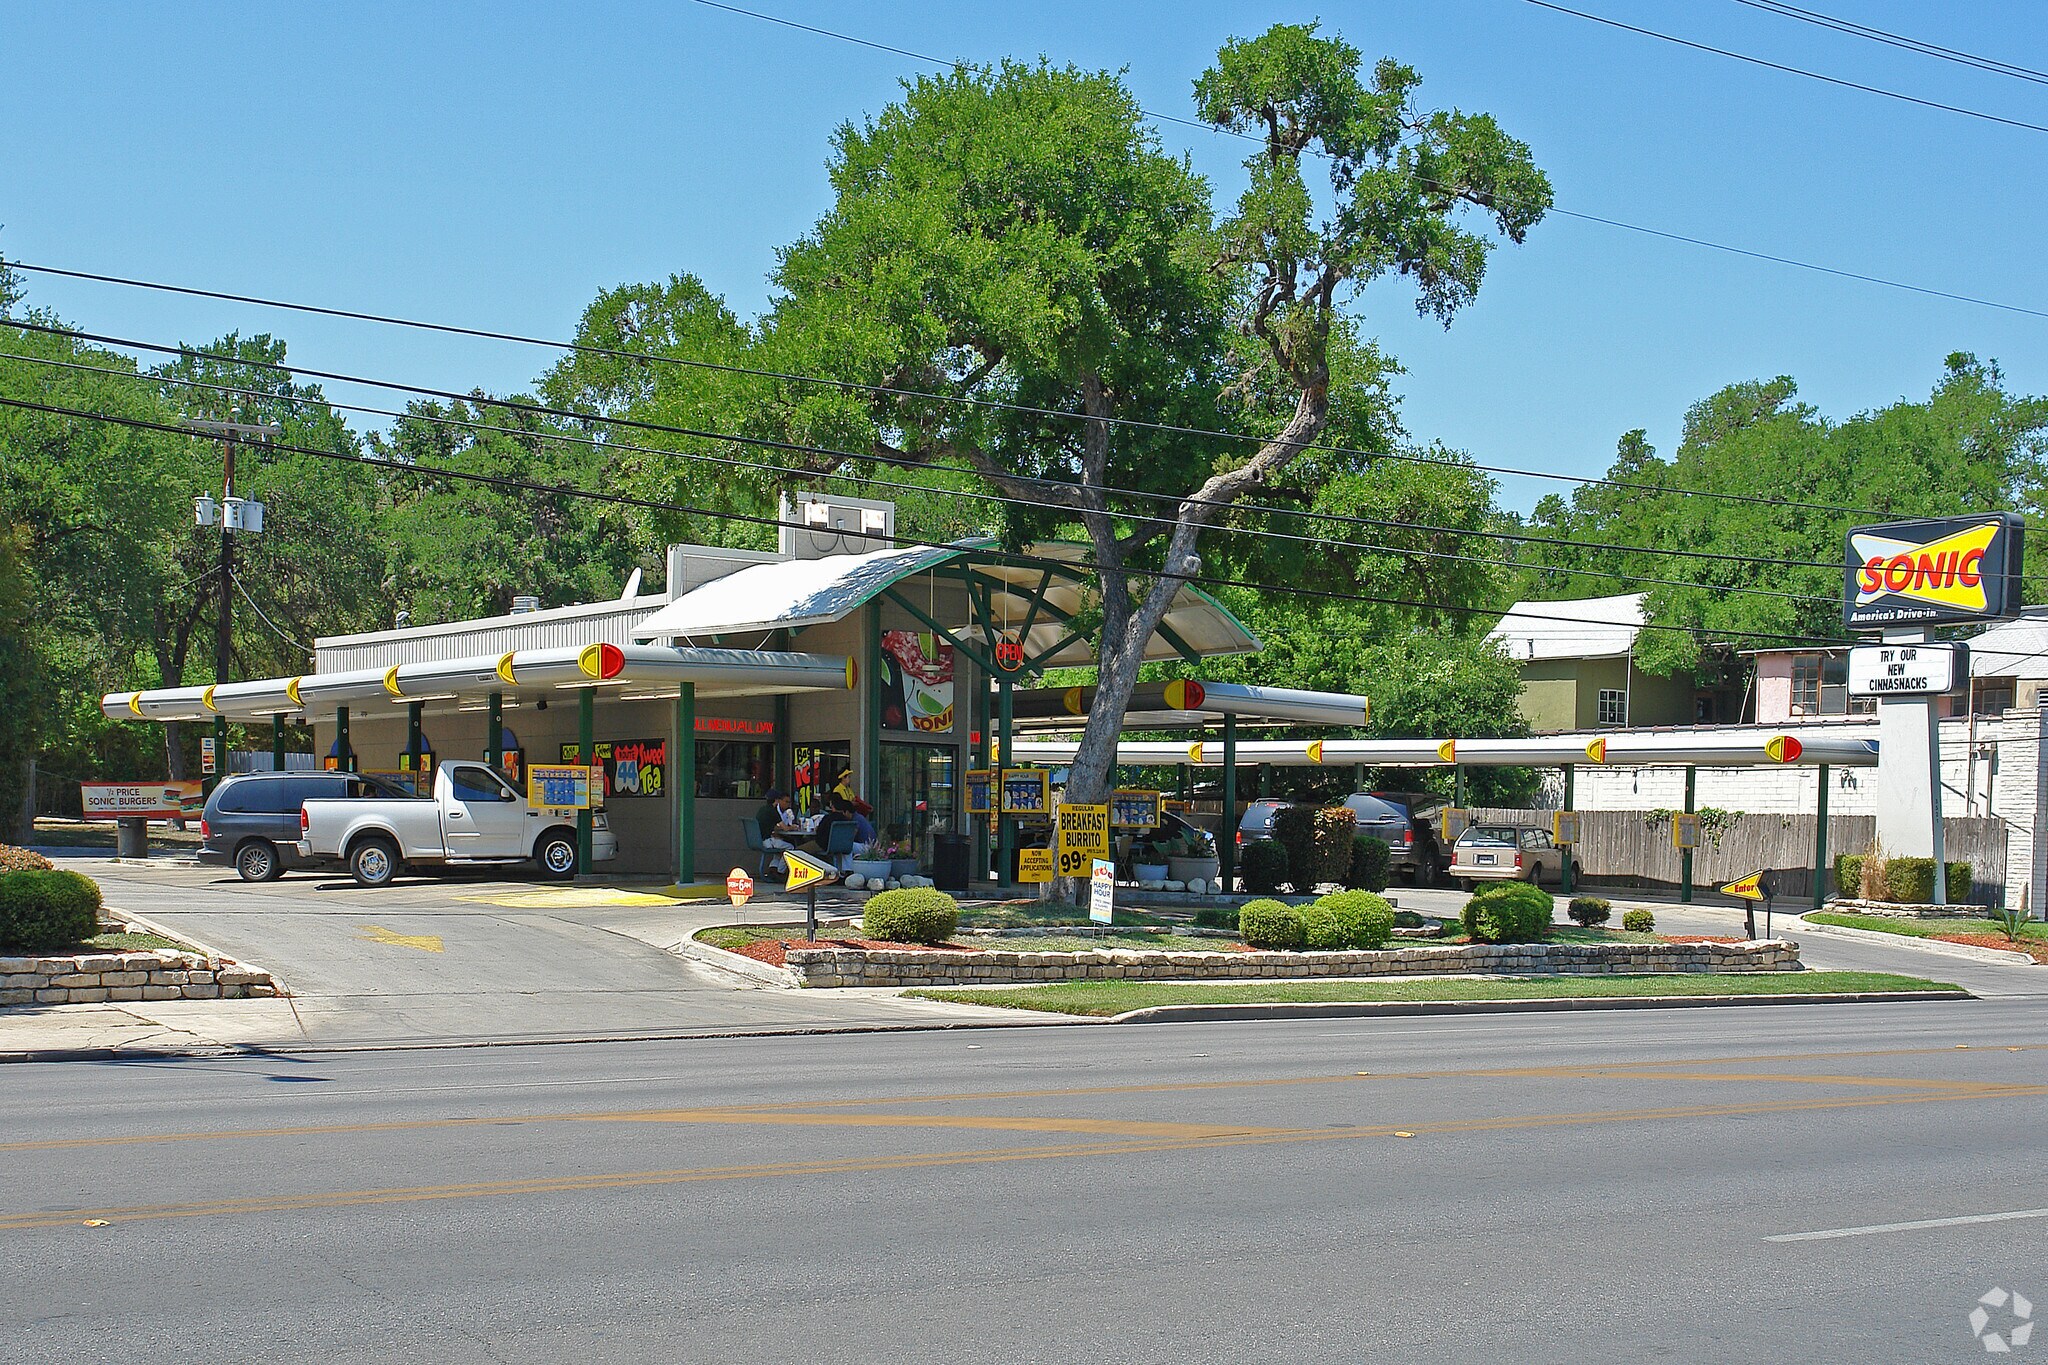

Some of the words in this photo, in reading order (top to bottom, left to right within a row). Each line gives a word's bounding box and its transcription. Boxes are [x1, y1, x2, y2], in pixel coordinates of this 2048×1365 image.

[1860, 548, 1985, 595] SONIC
[1851, 609, 1895, 622] America's
[998, 643, 1022, 660] OPEN
[1880, 650, 1895, 662] TRY
[1900, 649, 1916, 661] OUR
[1888, 664, 1905, 676] NEW
[1869, 677, 1927, 691] CINNASNACKS
[737, 720, 754, 733] ALL
[756, 722, 774, 734] DAY
[911, 710, 952, 731] SONI
[619, 749, 636, 759] ROUTE
[617, 761, 638, 786] 44
[640, 764, 661, 795] Tea
[117, 788, 140, 796] PRICE
[88, 797, 115, 806] SONIC
[118, 796, 157, 806] BURGERS
[1061, 812, 1106, 831] BREAKFAST
[1066, 832, 1101, 847] BURRITO
[794, 867, 808, 879] Exit
[1093, 881, 1113, 891] HAPPY
[1734, 884, 1755, 893] Enter
[1093, 889, 1111, 898] HOUR
